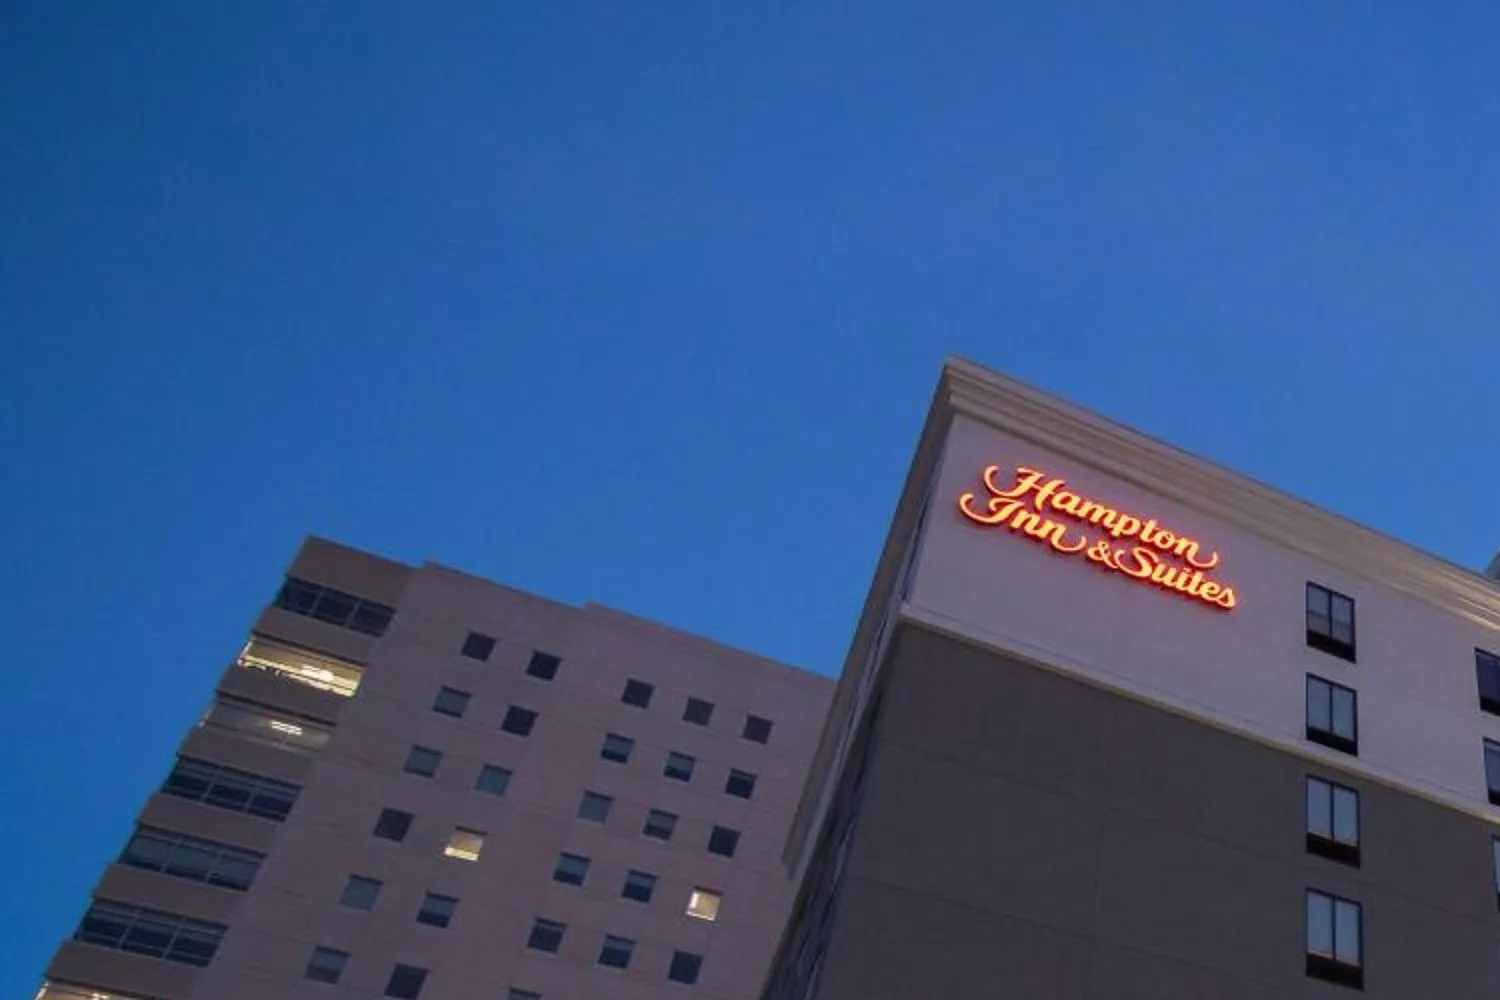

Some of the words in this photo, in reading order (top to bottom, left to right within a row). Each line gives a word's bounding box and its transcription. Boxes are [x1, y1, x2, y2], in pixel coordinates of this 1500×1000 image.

[958, 492, 1088, 553] Inn
[1087, 540, 1120, 569] &
[1113, 546, 1238, 610] Suites
[983, 464, 1219, 569] Hampton
